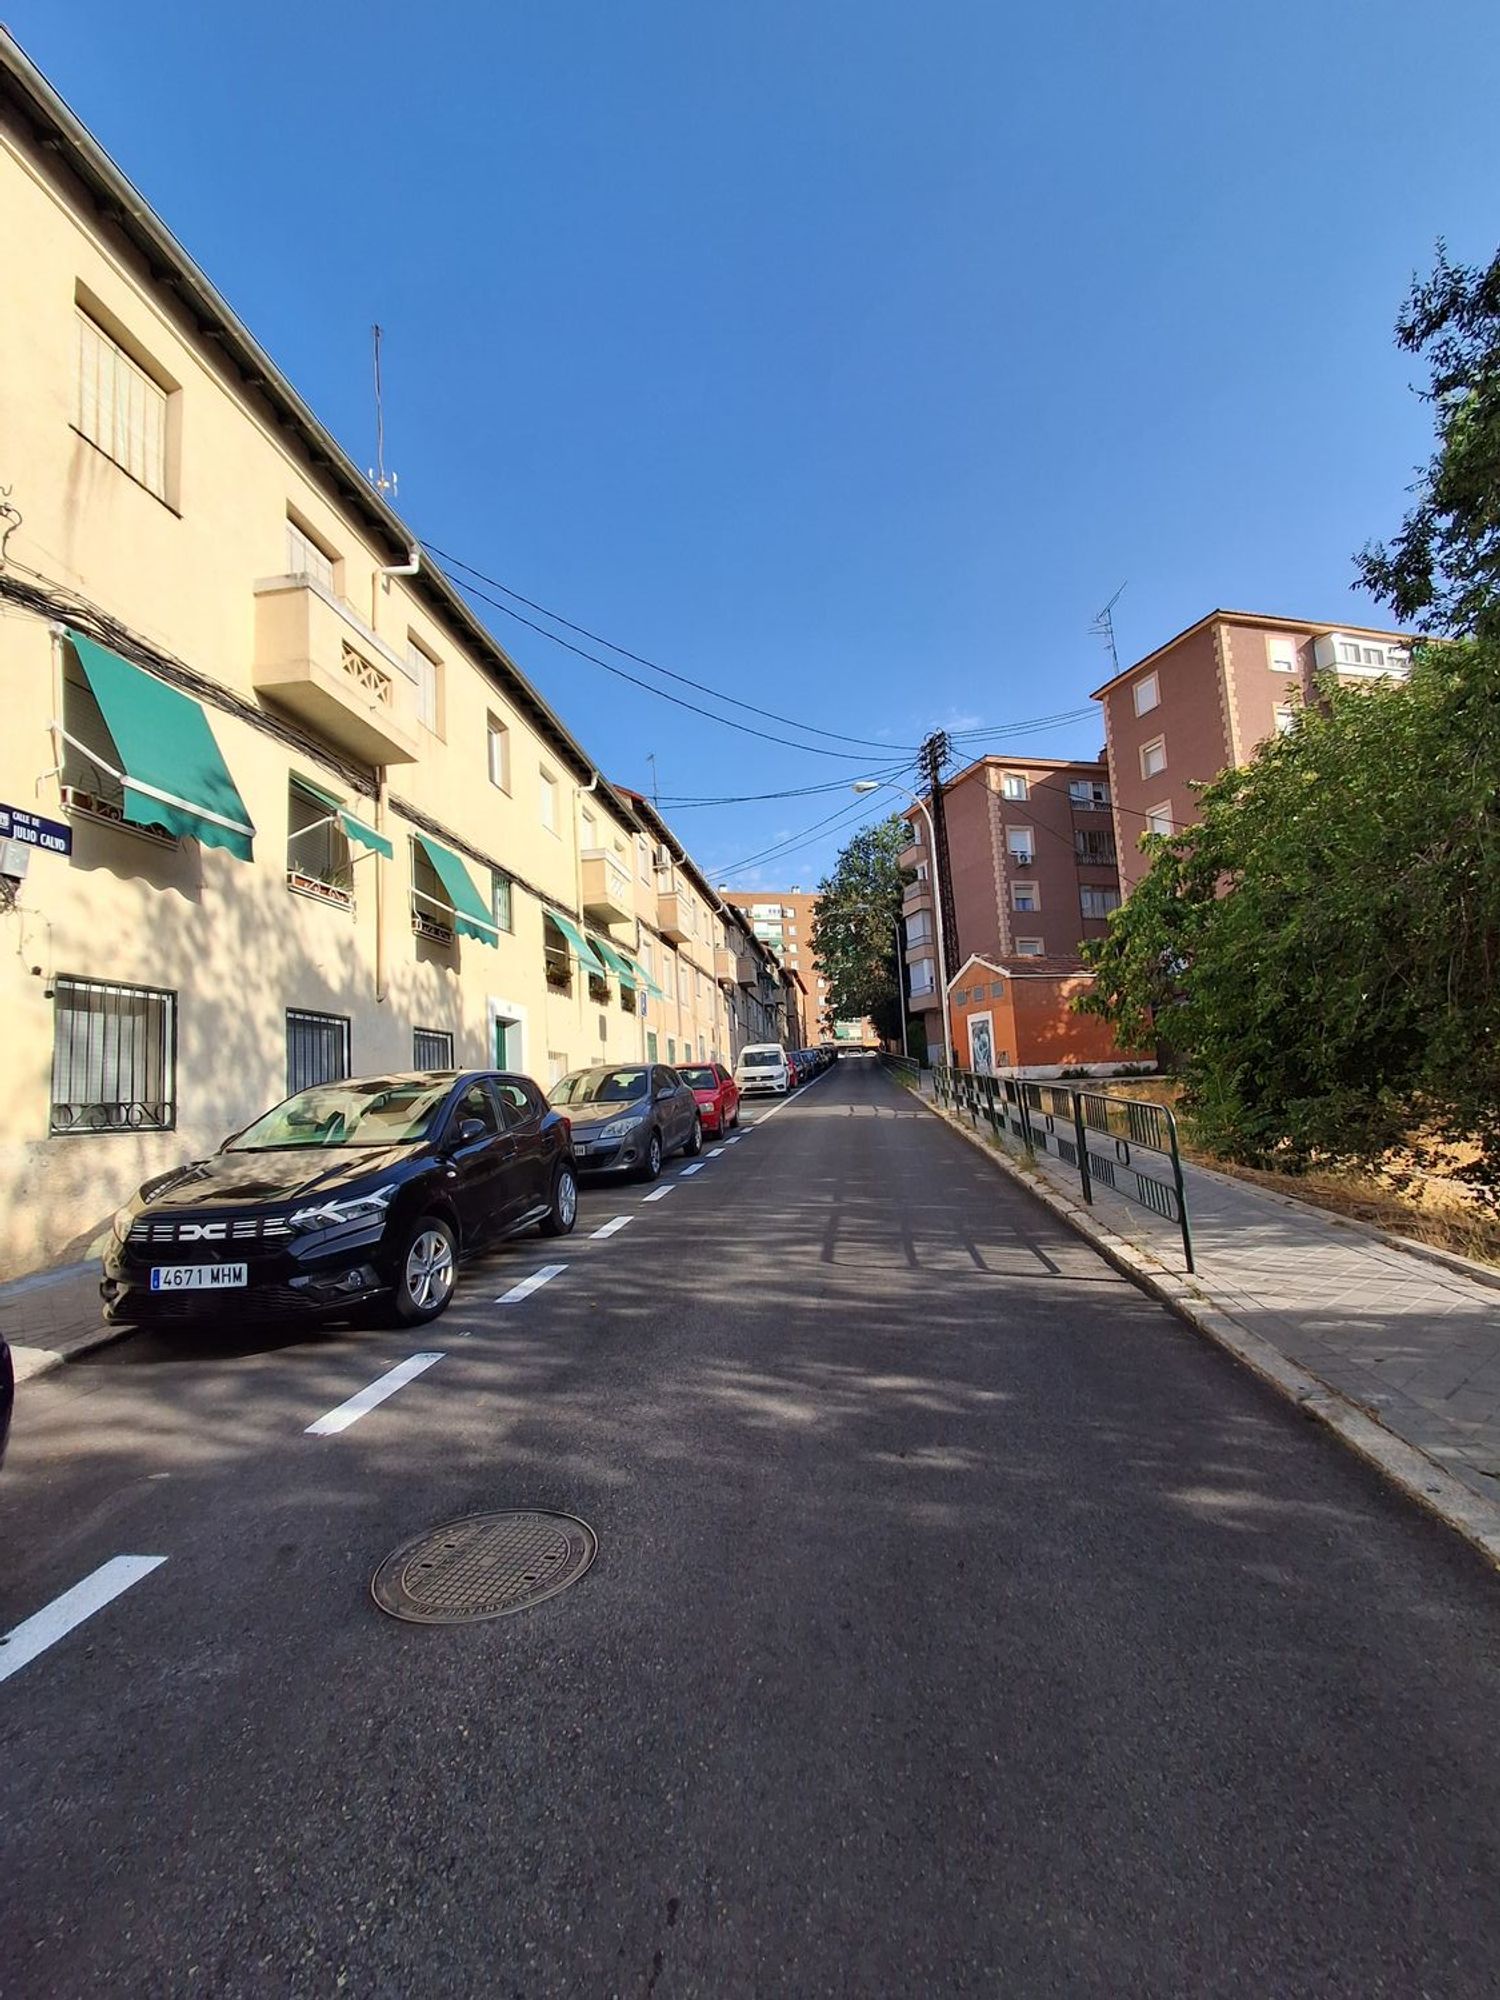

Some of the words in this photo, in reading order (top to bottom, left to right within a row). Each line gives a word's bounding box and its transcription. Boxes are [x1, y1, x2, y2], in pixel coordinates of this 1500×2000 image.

[12, 811, 30, 825] CALLE
[31, 817, 40, 828] DE
[13, 824, 37, 843] JULIO
[40, 833, 66, 851] CALVO
[163, 1269, 202, 1286] 4671
[210, 1266, 243, 1284] MHM
